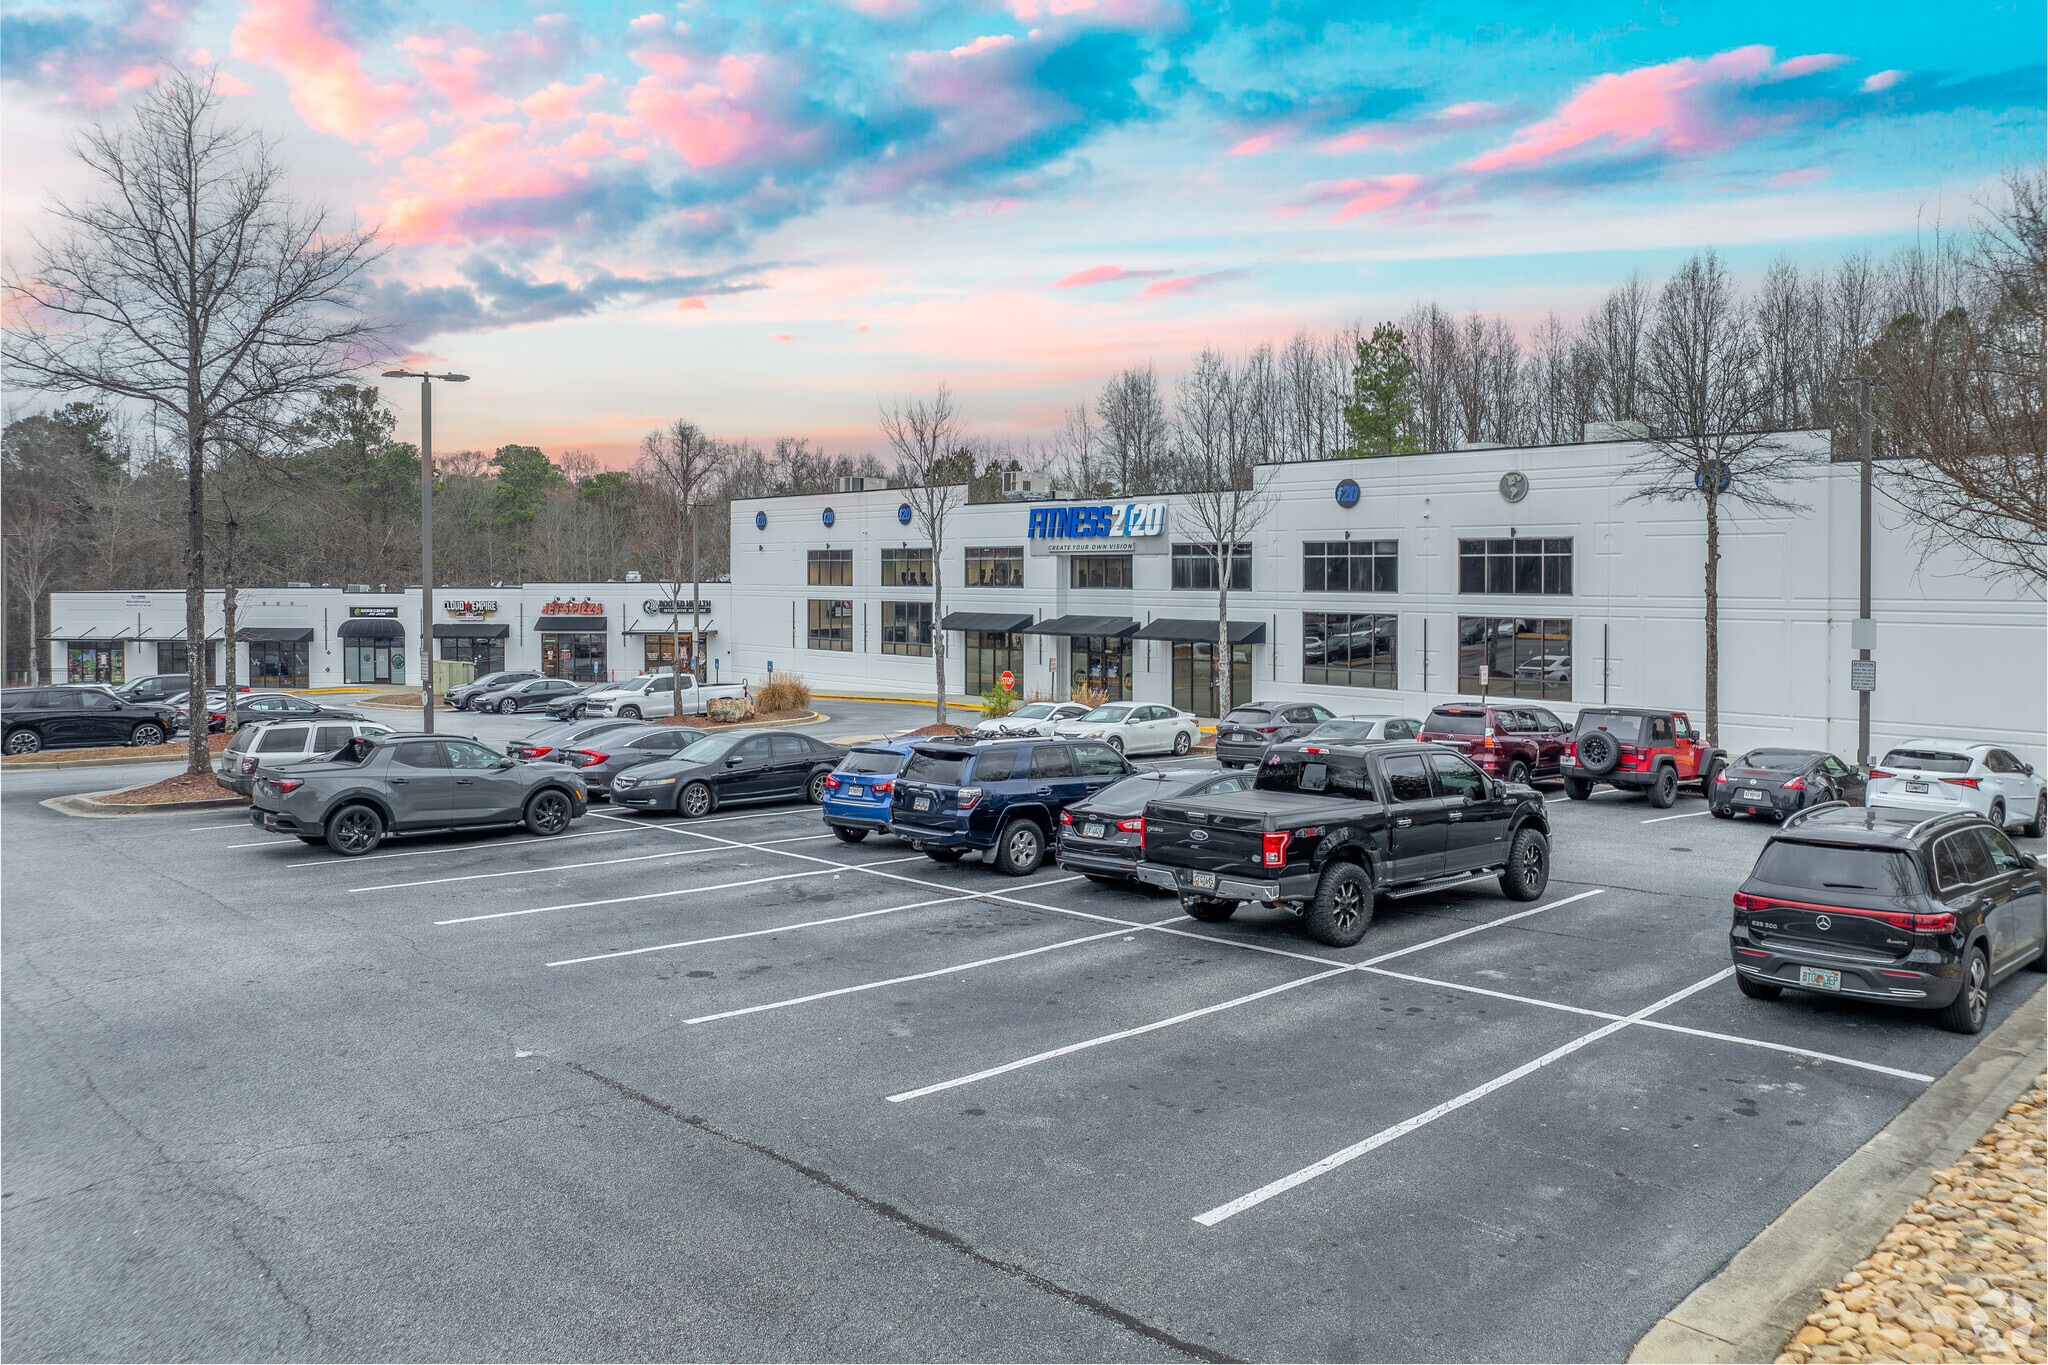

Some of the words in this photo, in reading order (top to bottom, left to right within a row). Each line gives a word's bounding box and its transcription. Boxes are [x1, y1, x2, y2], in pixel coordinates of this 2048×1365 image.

[1337, 485, 1359, 502] f20
[1027, 505, 1113, 539] FITNESS
[444, 601, 465, 610] CLOUD
[472, 601, 497, 610] EMPIRE
[542, 603, 569, 615] JET'S
[571, 603, 603, 615] PIZZA
[1002, 676, 1014, 685] STOP
